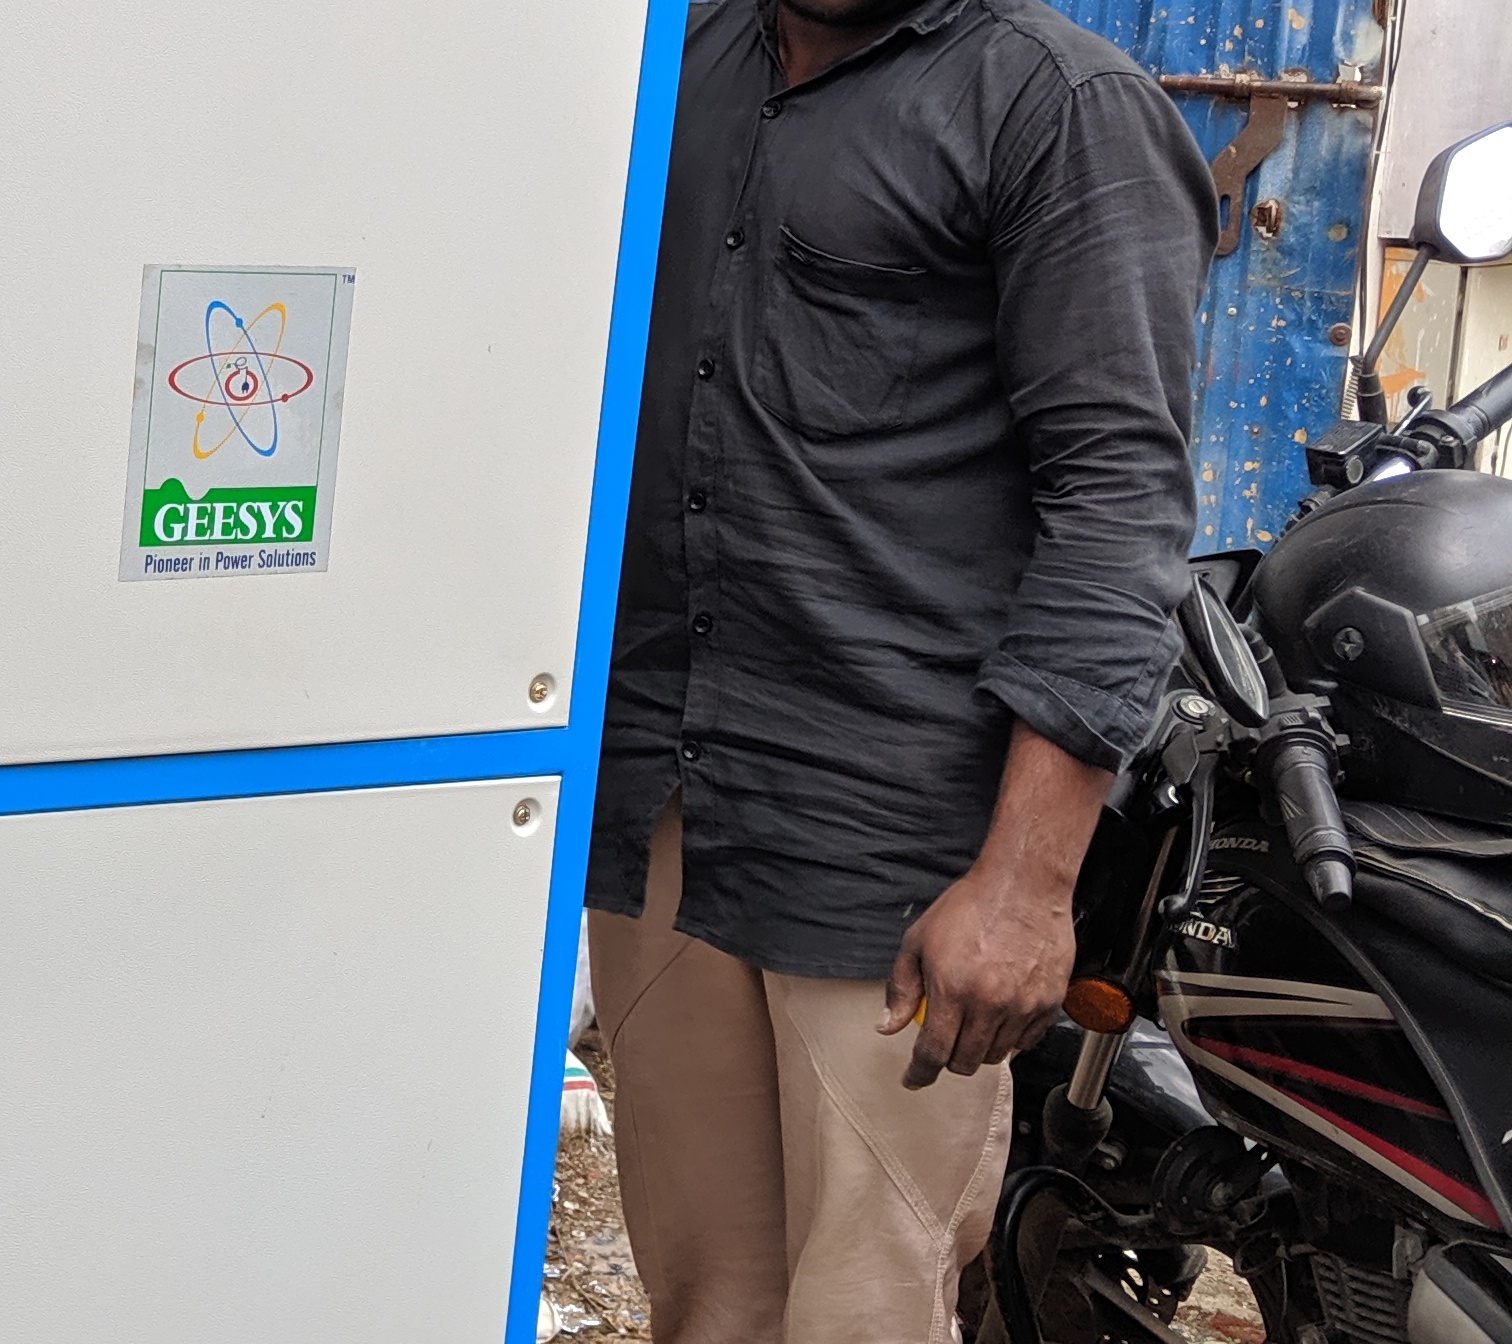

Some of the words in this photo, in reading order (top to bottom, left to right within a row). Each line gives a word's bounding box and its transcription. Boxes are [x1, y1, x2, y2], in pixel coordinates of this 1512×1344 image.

[153, 500, 304, 542] GEESYS
[144, 554, 195, 574] Pioneer
[198, 552, 210, 571] in
[215, 552, 255, 571] Power
[257, 549, 316, 569] Solutions
